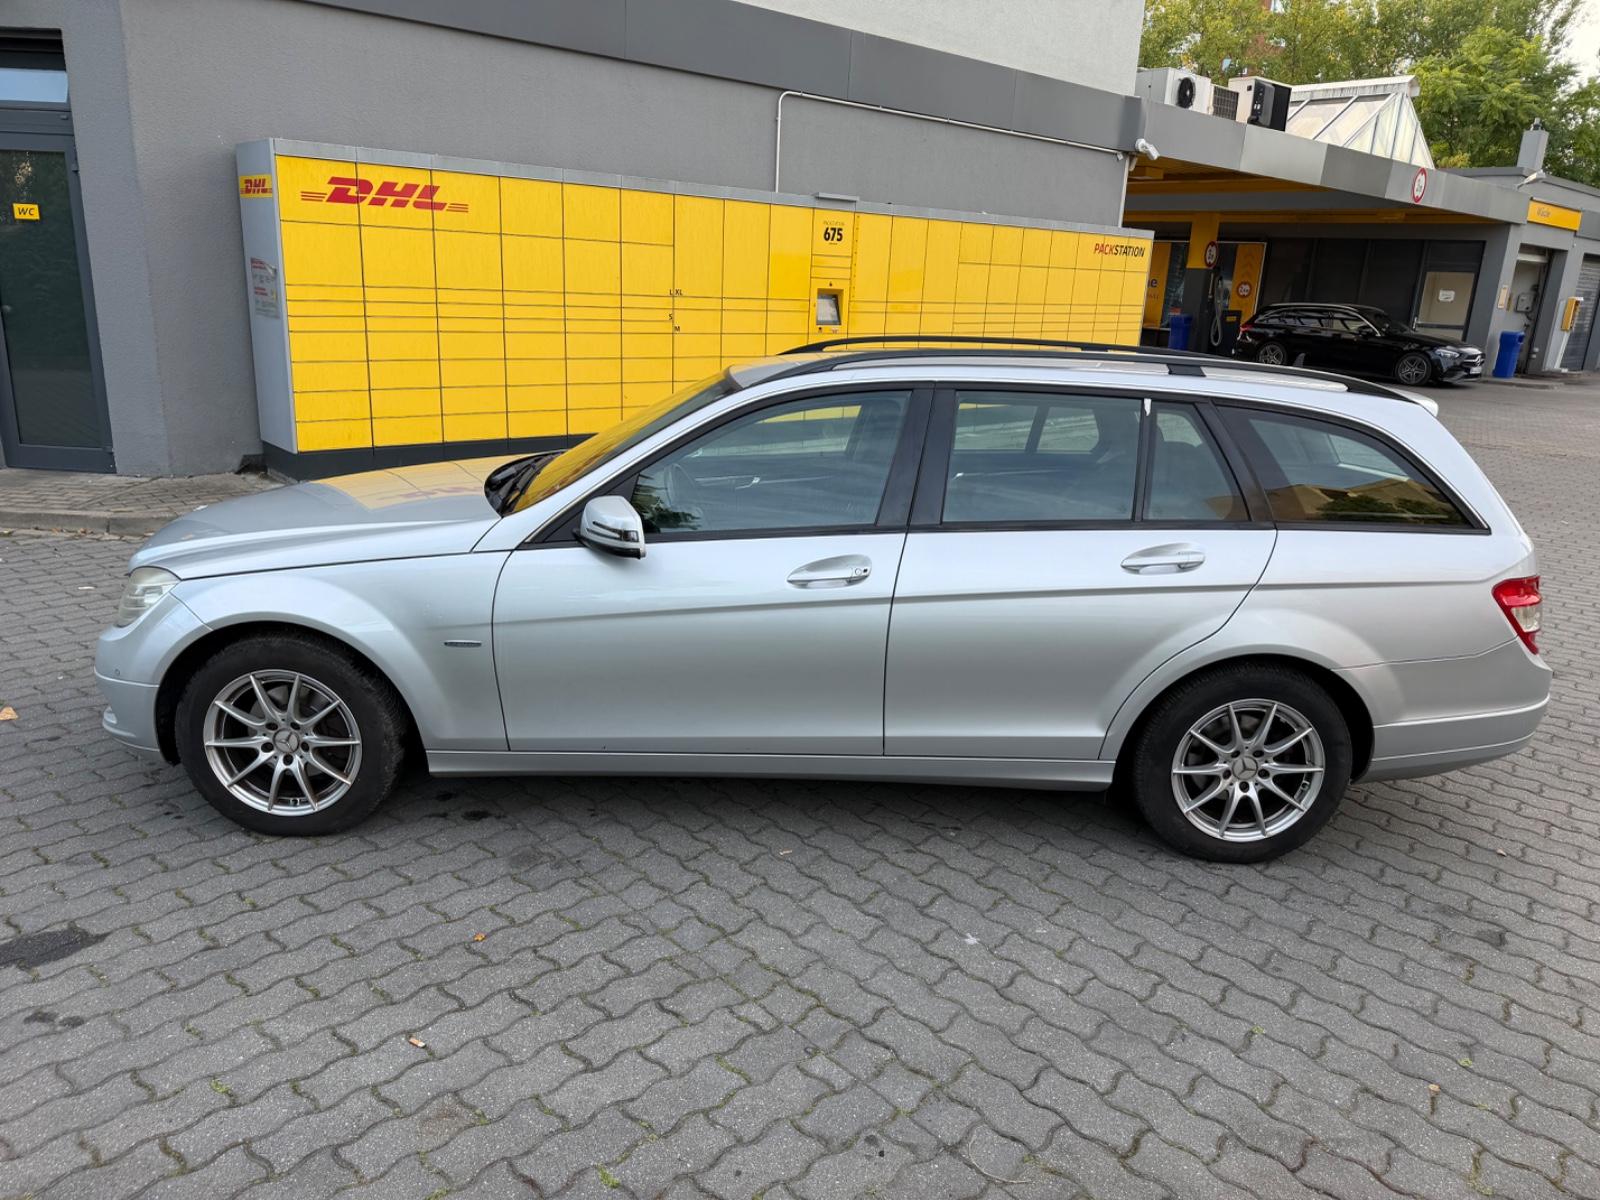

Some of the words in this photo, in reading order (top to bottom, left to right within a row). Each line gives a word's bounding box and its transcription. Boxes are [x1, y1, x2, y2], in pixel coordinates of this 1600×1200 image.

[243, 178, 269, 194] DHL
[325, 176, 448, 212] DHL
[17, 207, 35, 216] WC
[823, 226, 844, 242] 675
[1093, 243, 1146, 258] PACKSTATION
